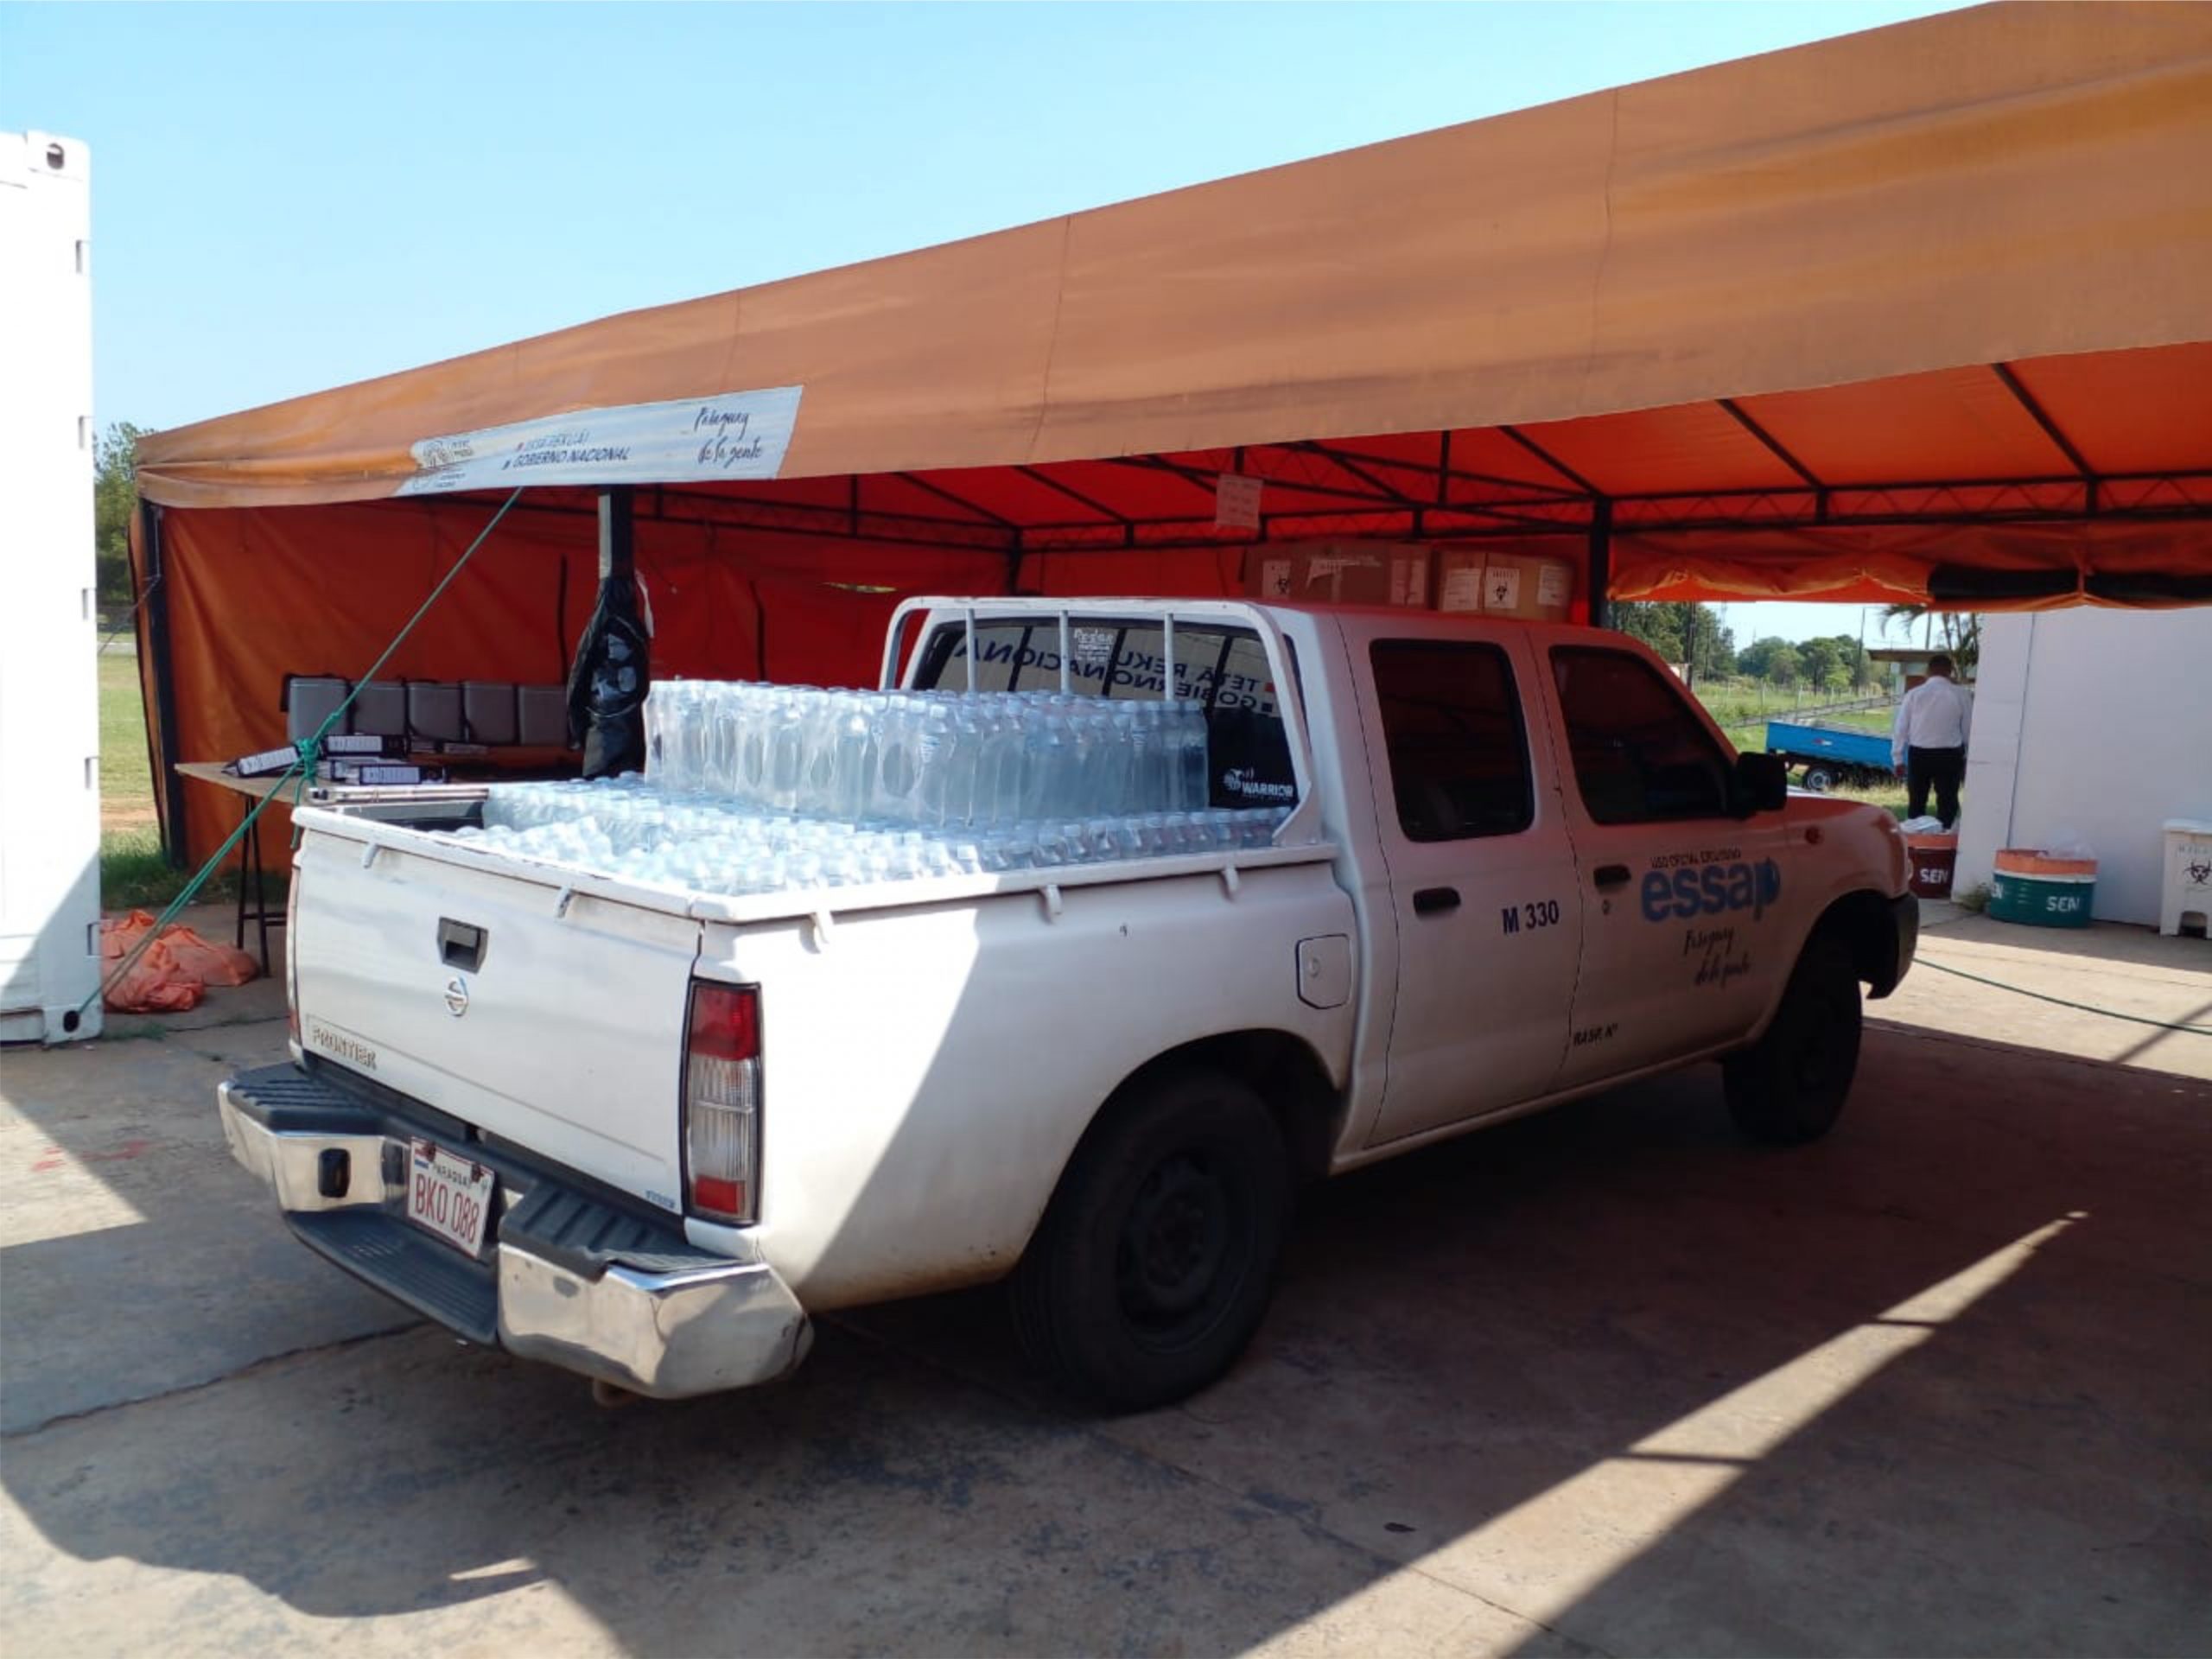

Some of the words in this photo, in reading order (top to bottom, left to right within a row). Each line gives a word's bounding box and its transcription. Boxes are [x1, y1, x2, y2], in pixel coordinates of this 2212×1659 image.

[567, 446, 631, 463] NACIONAL
[723, 435, 763, 468] gente
[1243, 781, 1294, 798] WARRIOR
[1642, 856, 1781, 922] essap
[1919, 868, 1949, 884] SEN
[1502, 907, 1520, 934] M
[1525, 900, 1560, 931] 330
[2046, 896, 2081, 912] SEN
[312, 1025, 378, 1071] FRONTIER
[450, 1191, 480, 1244] 088
